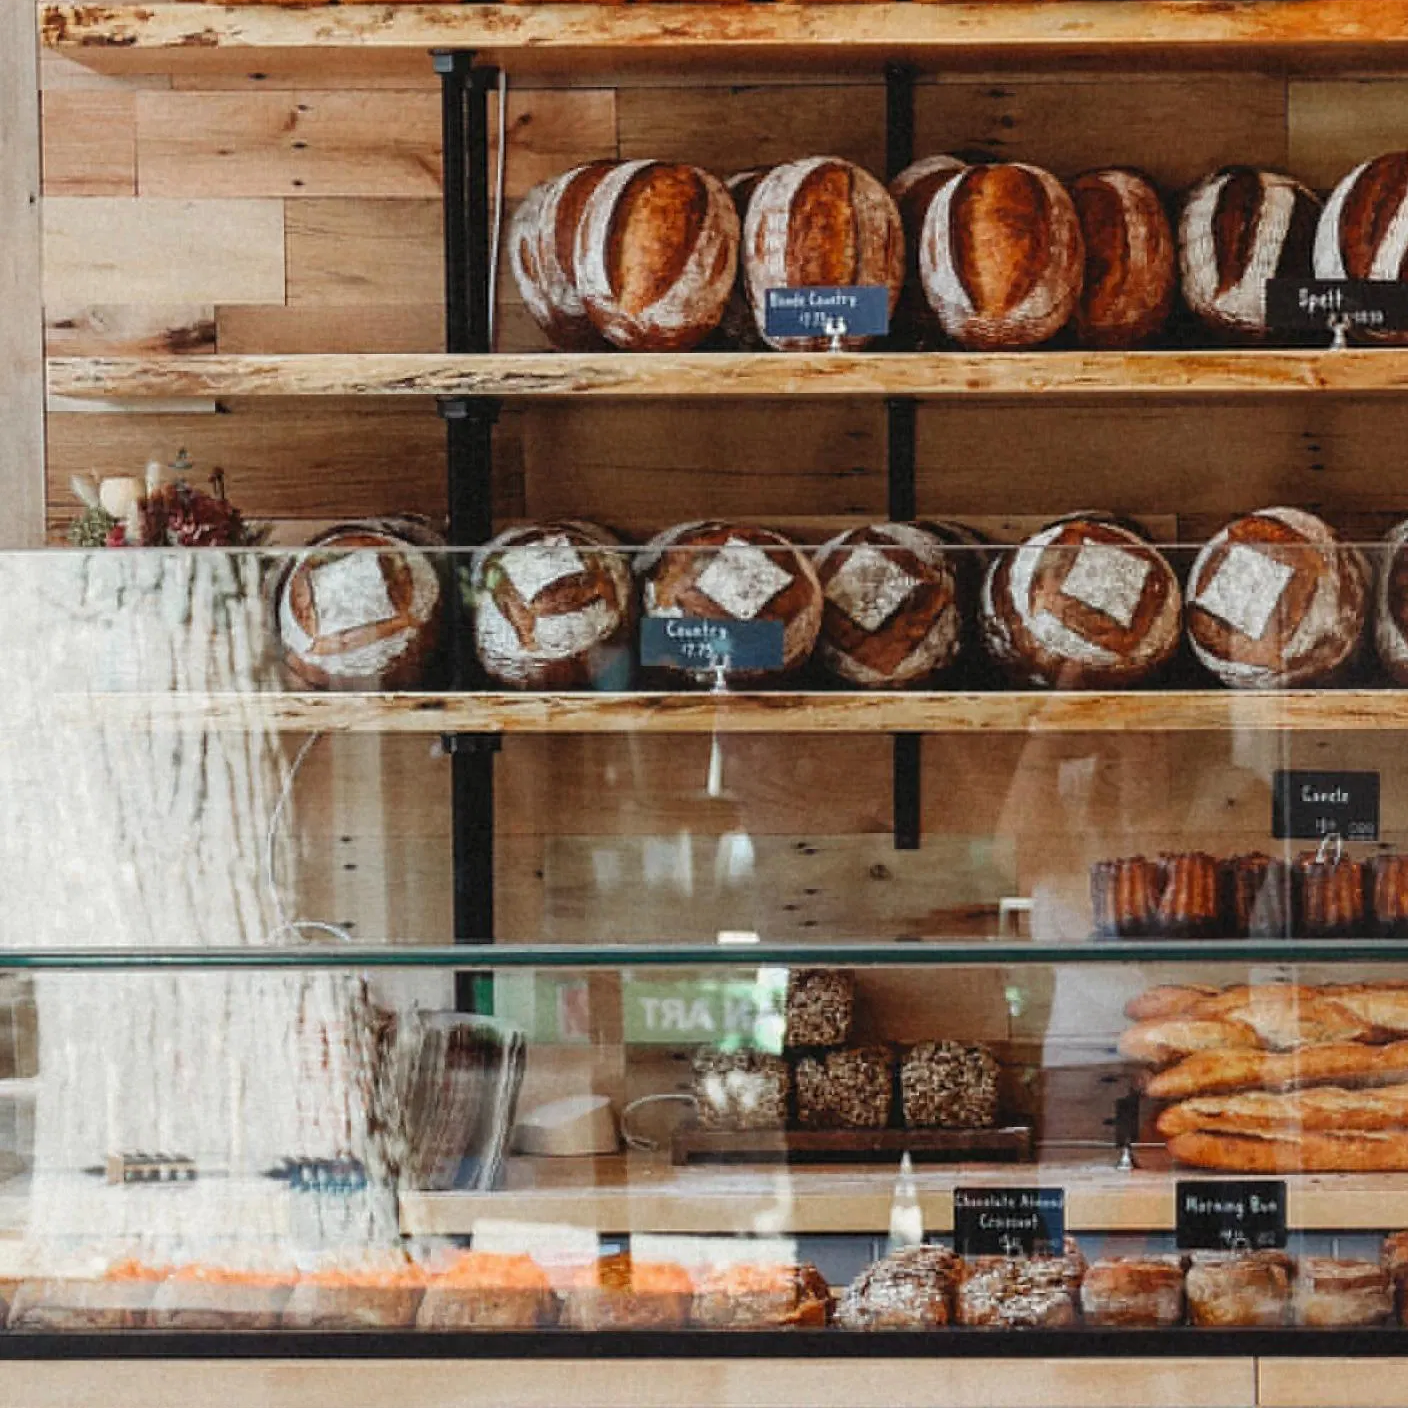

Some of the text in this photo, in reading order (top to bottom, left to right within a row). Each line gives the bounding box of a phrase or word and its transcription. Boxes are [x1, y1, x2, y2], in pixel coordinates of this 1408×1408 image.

[809, 289, 857, 308] Country
[666, 620, 727, 641] Country
[1186, 1196, 1244, 1220] Morning
